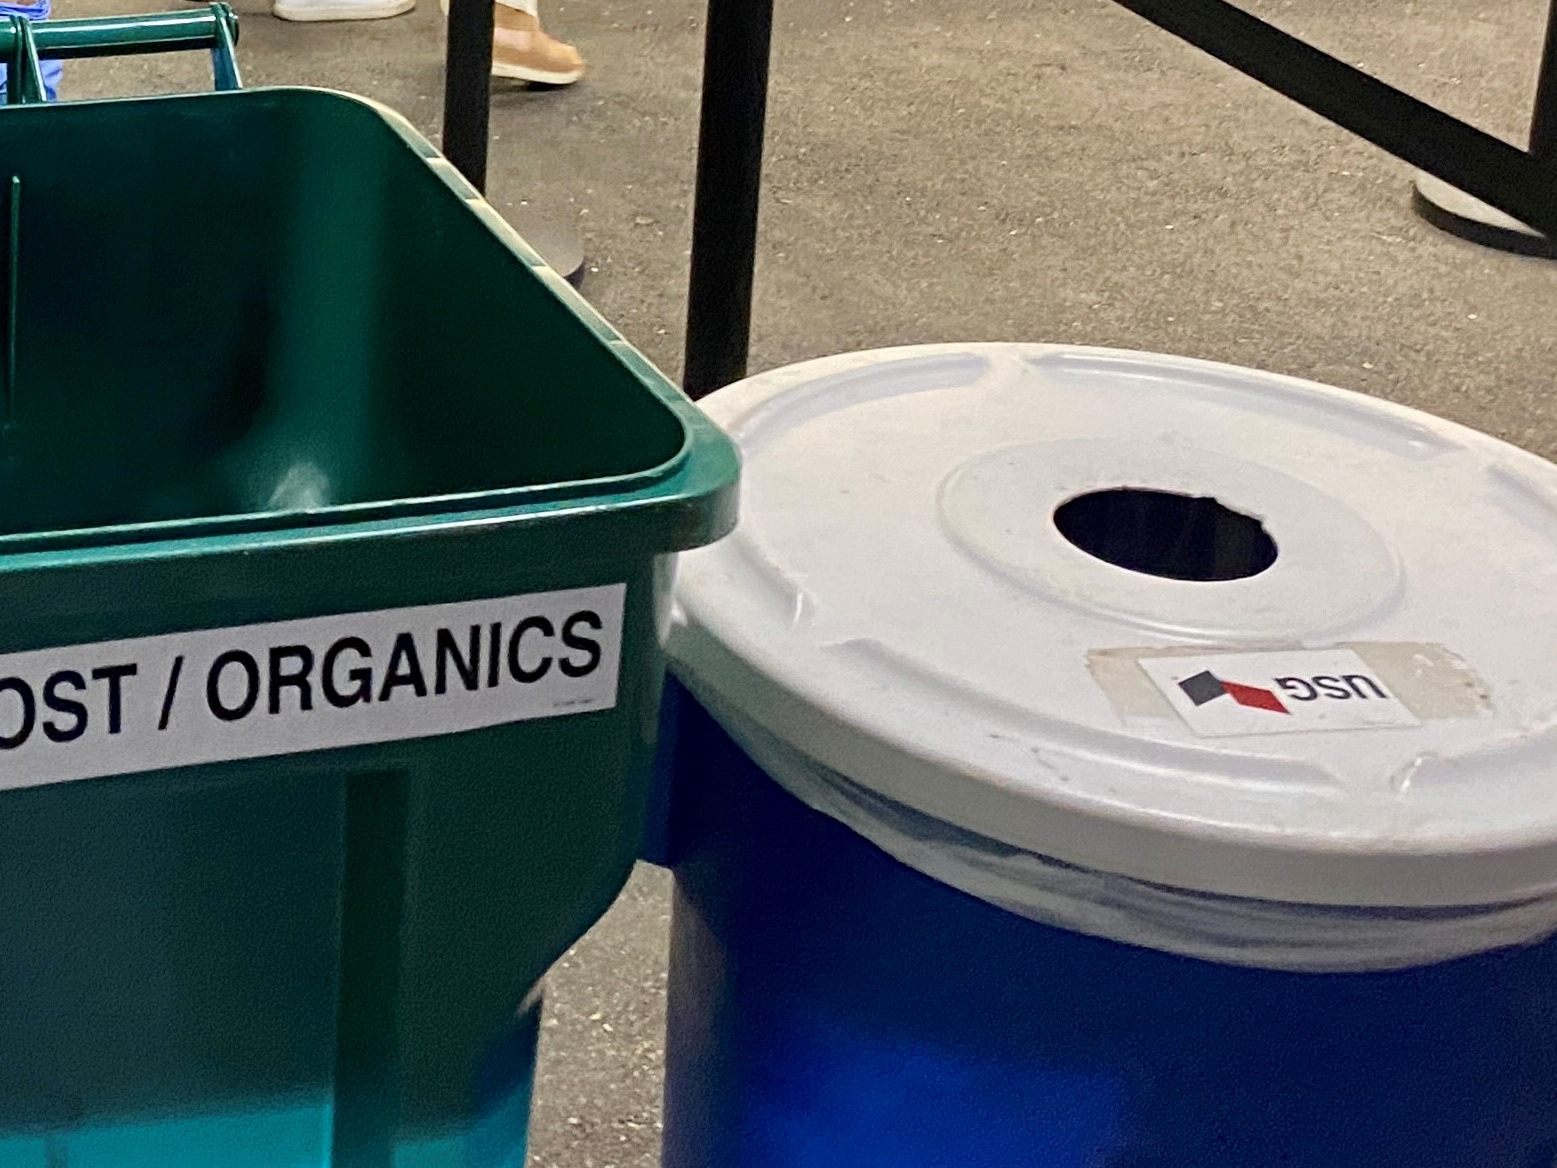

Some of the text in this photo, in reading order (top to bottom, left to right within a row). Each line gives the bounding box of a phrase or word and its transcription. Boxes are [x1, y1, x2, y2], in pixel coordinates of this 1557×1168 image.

[158, 656, 185, 731] /
[205, 609, 603, 723] ORGANICS
[1272, 673, 1389, 702] USG
